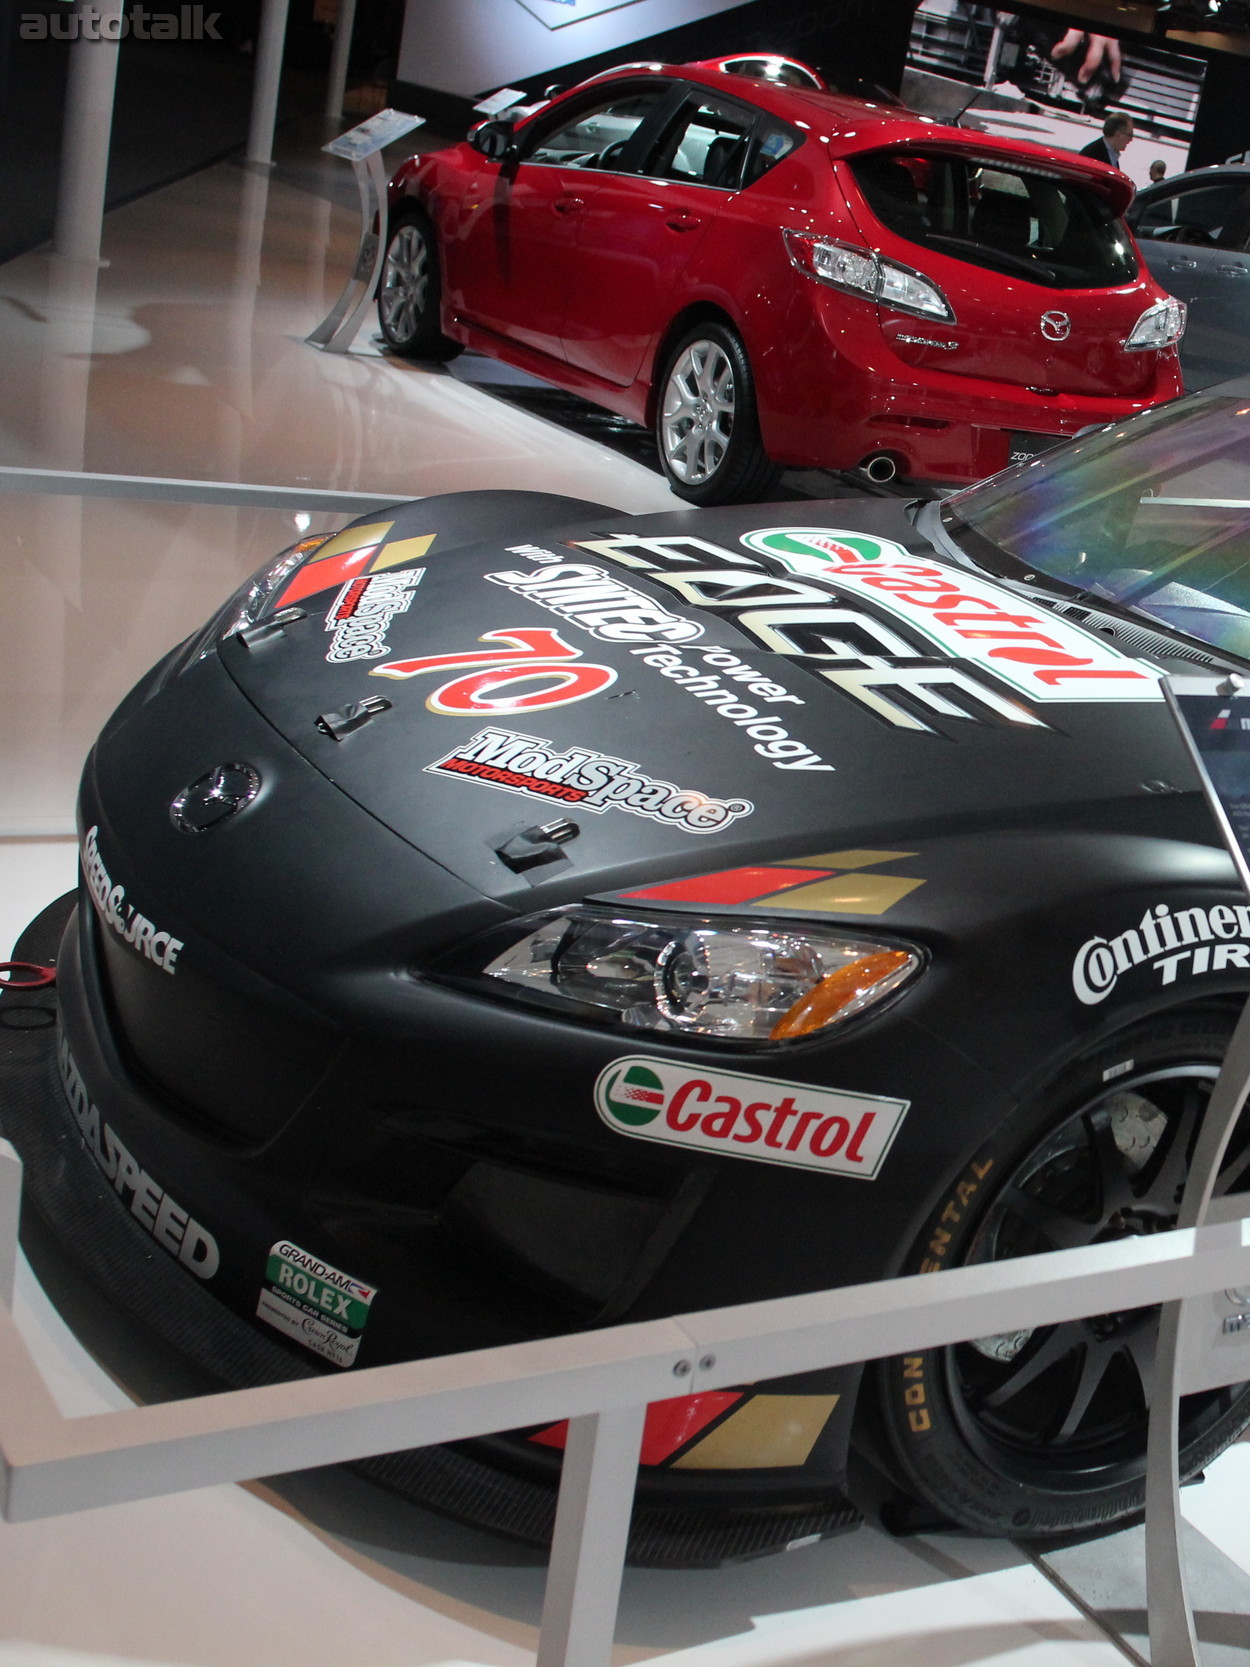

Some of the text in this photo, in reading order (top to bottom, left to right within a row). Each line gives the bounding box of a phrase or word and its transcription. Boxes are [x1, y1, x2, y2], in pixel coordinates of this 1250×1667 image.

[504, 544, 565, 564] With
[568, 532, 1052, 732] EDGE
[821, 562, 1149, 686] Castrol
[368, 627, 618, 716] 70
[630, 643, 835, 771] Technology
[679, 645, 805, 705] Power
[439, 758, 590, 802] MOTORSPORTS
[58, 1037, 220, 1280] AZDASPEED
[665, 1079, 877, 1163] Castrol
[271, 1286, 349, 1333] SPORTS CAR SERIES
[278, 1263, 354, 1320] ROLEX
